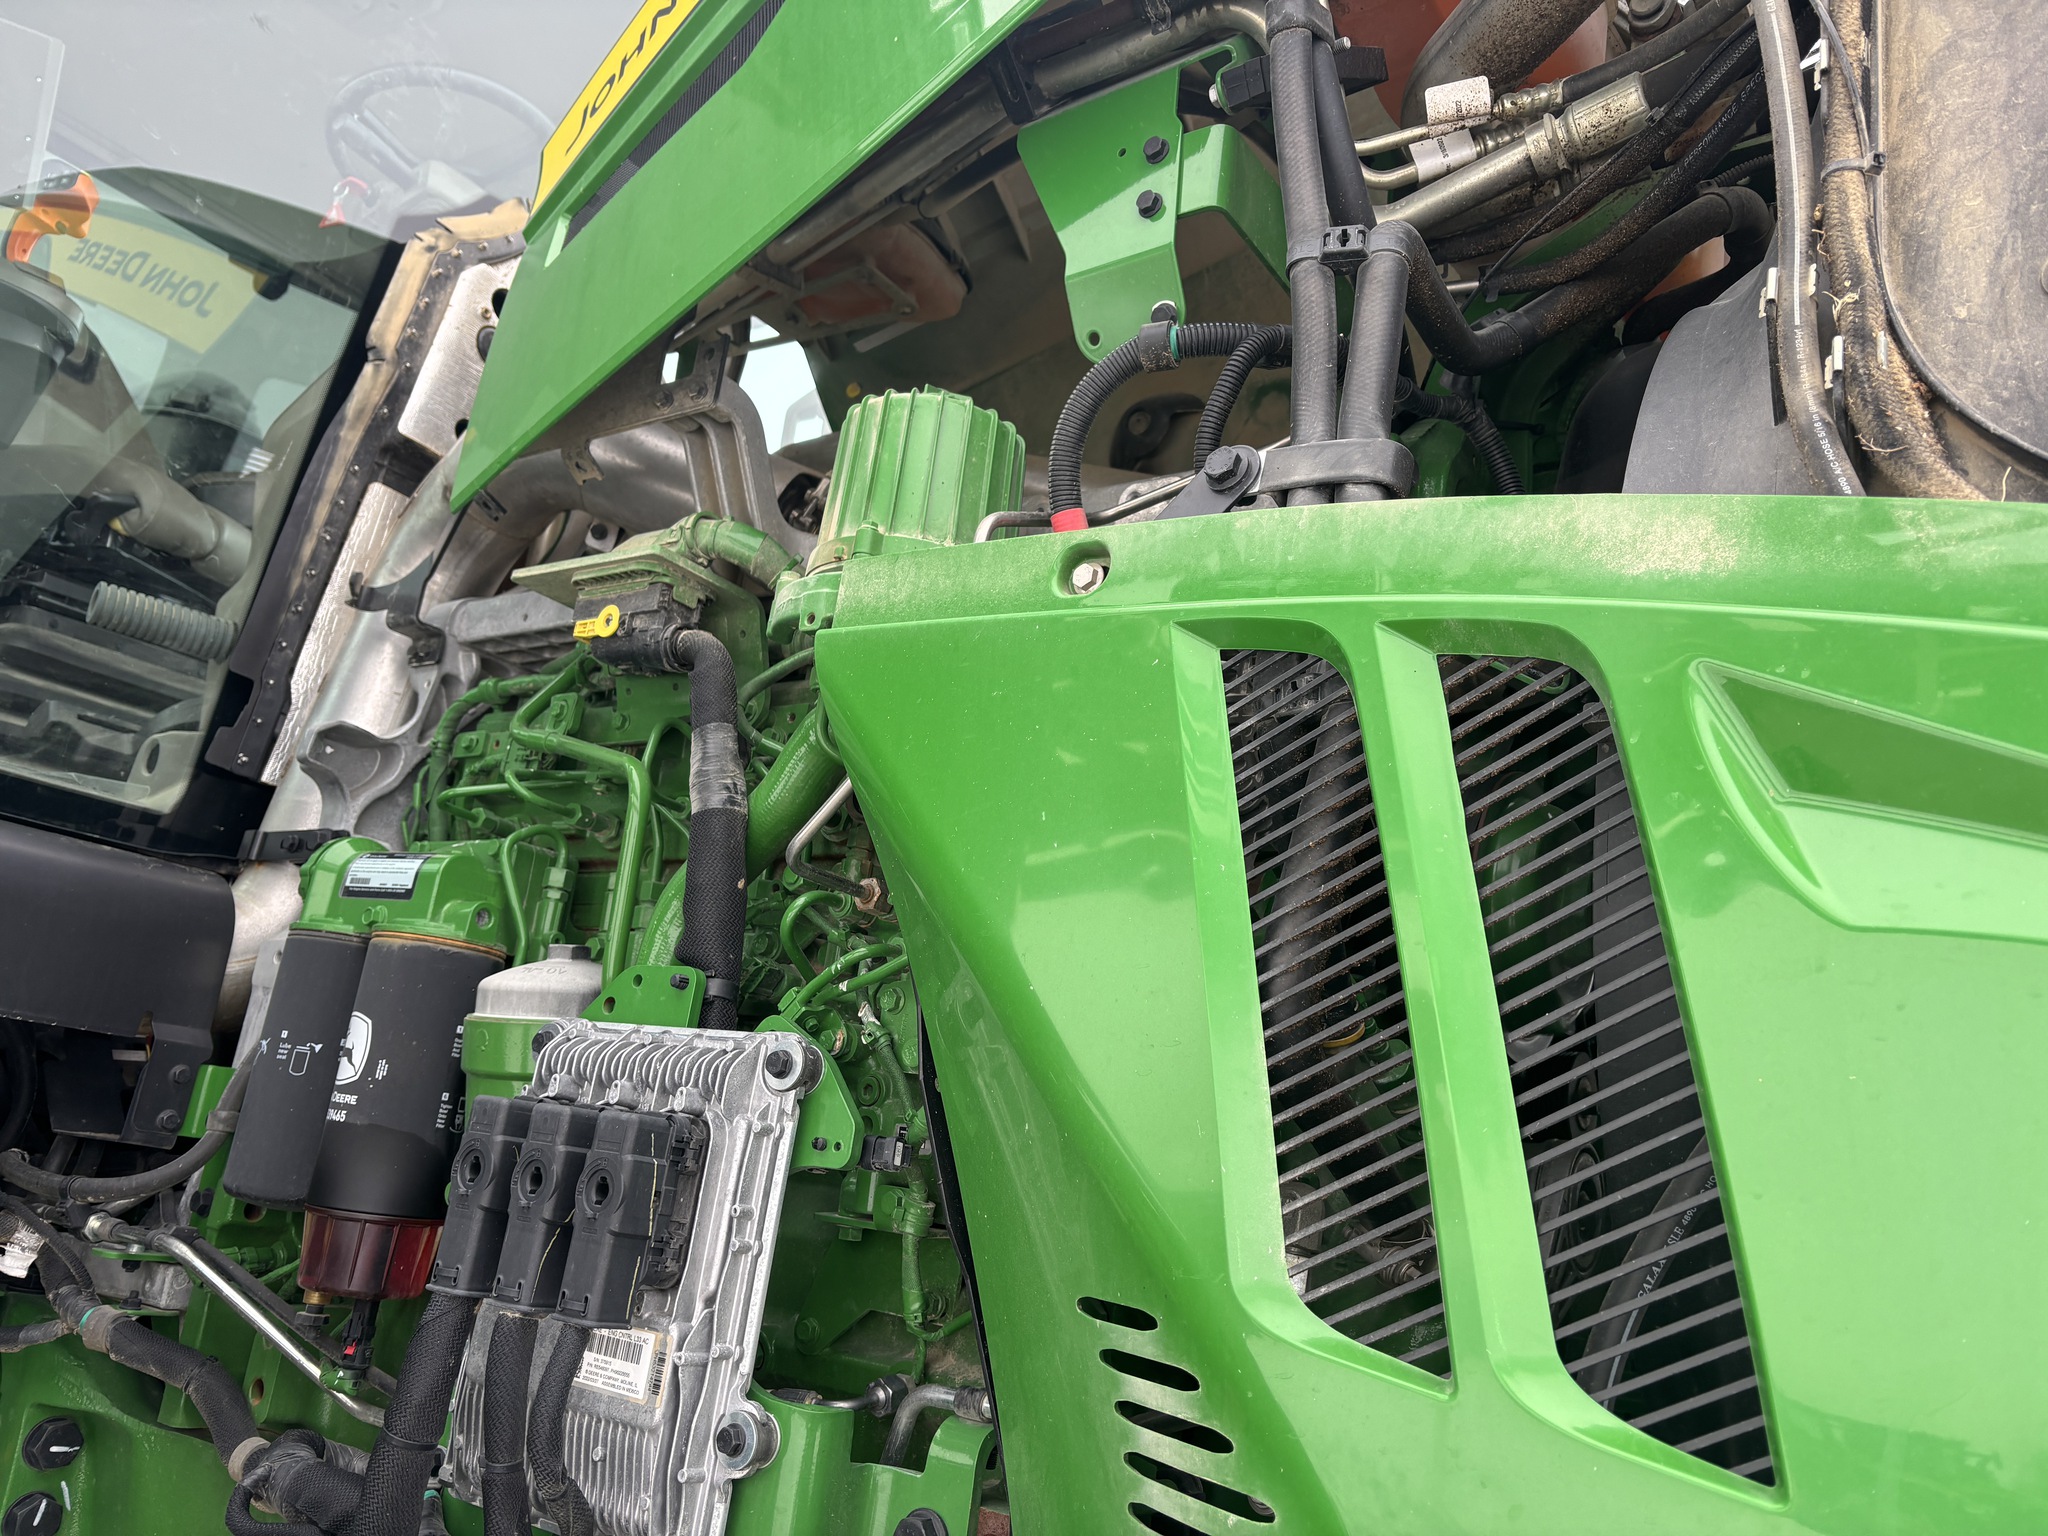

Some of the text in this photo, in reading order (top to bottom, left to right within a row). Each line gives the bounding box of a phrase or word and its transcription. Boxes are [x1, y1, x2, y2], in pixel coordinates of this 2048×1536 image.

[565, 0, 677, 156] JOHN
[1684, 104, 1739, 168] PERFORMANCE
[1819, 438, 1836, 461] HOSE
[1830, 460, 1843, 475] A/C
[1837, 476, 1852, 494] 4890
[280, 1042, 292, 1050] Lube
[331, 1091, 358, 1105] DEERE
[607, 1329, 617, 1337] ENG
[601, 1380, 621, 1391] ASSEMBLED
[626, 1387, 640, 1395] MEXICO
